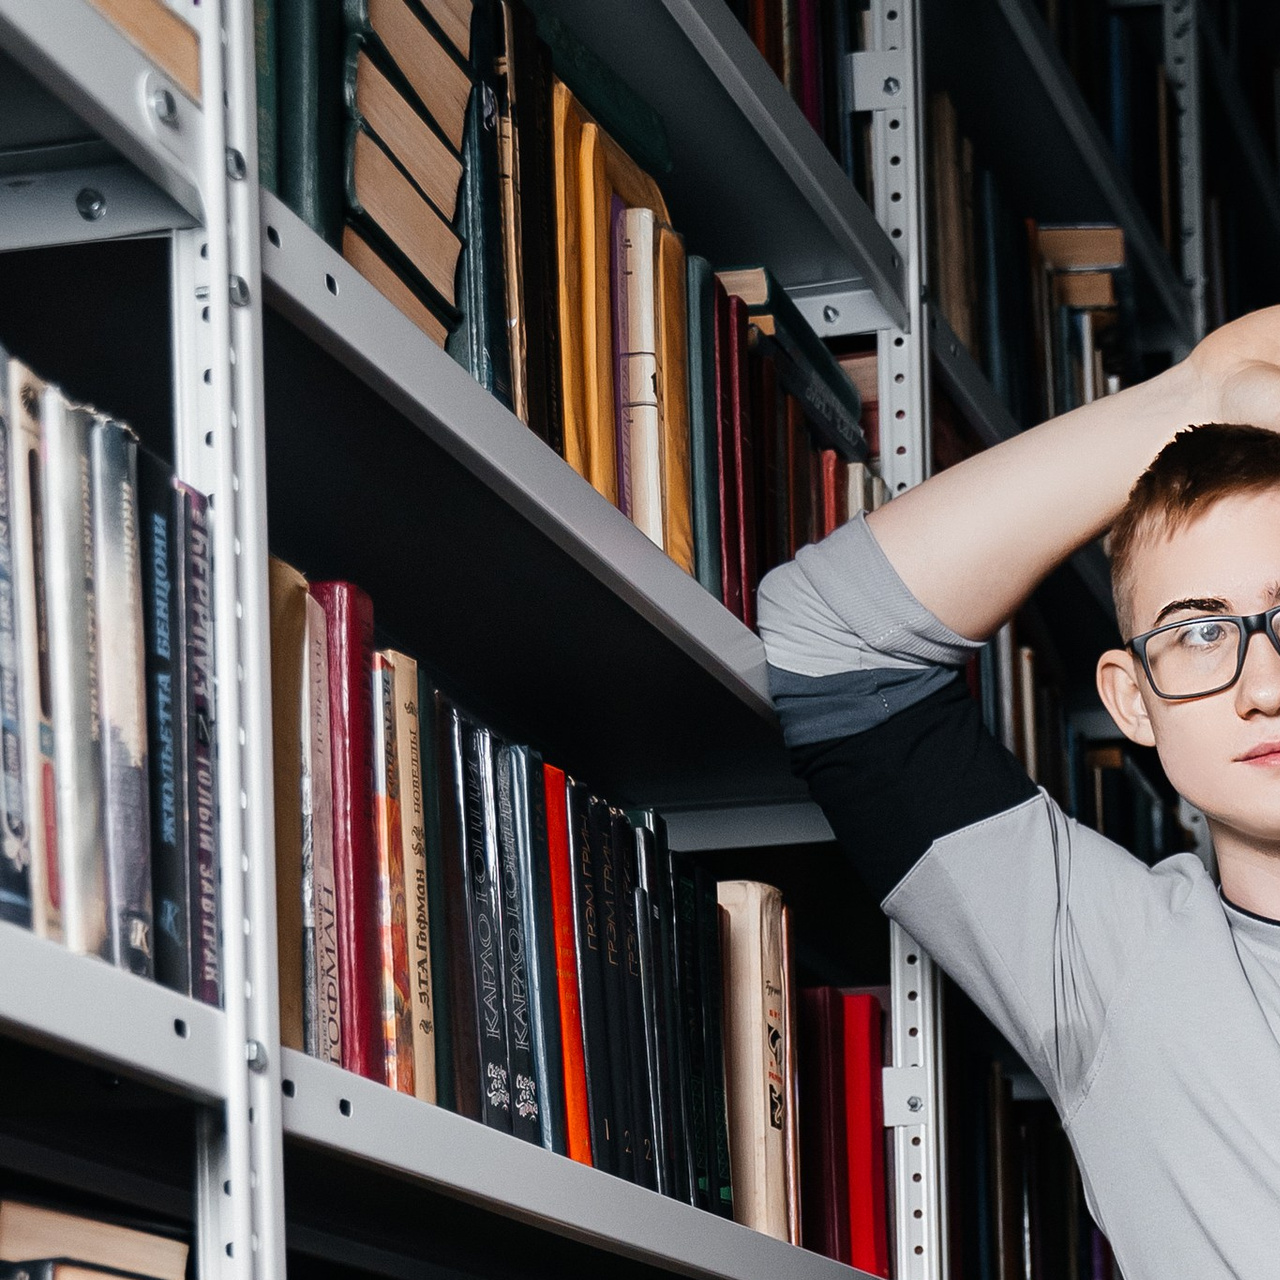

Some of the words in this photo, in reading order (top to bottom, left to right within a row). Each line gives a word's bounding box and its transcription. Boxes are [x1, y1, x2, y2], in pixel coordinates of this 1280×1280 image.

[151, 515, 172, 662] БЕНЦОНИ
[156, 673, 177, 847] ЖЮЛЬЕТТА
[196, 756, 213, 851] ГОЛЫЙ
[408, 728, 420, 815] НОВЕЛЛЫ
[578, 814, 592, 878] ГРИН
[602, 832, 613, 896] ГРИН
[199, 863, 218, 983] ЗАВТРАК
[583, 883, 598, 951] ГРЭМ
[605, 899, 619, 967] ГРЭМ
[321, 882, 340, 1065] ГОФМАН
[476, 913, 502, 1040] КАРЛО
[507, 927, 530, 1054] КАРЛО
